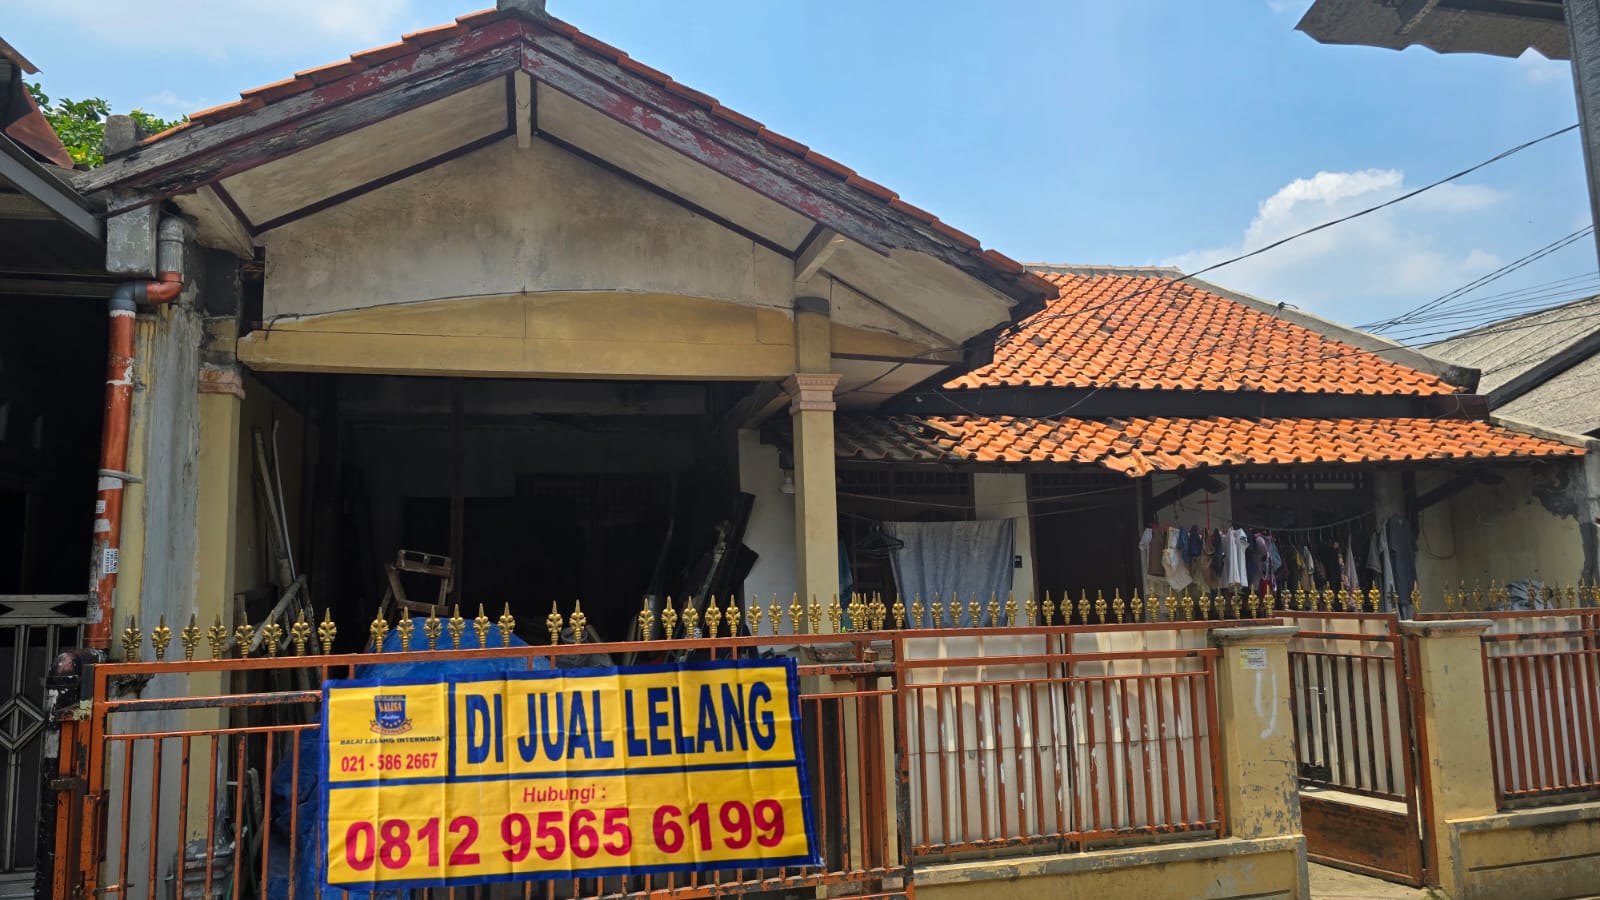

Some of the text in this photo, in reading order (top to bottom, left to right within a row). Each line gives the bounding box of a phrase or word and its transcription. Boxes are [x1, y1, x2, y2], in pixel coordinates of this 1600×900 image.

[465, 681, 776, 764] DI JUAL LELANG
[341, 755, 365, 773] 021
[377, 754, 402, 771] 586
[405, 752, 438, 770] 2667
[523, 784, 596, 804] Hubungi
[345, 798, 785, 871] 0812 9565 6199
